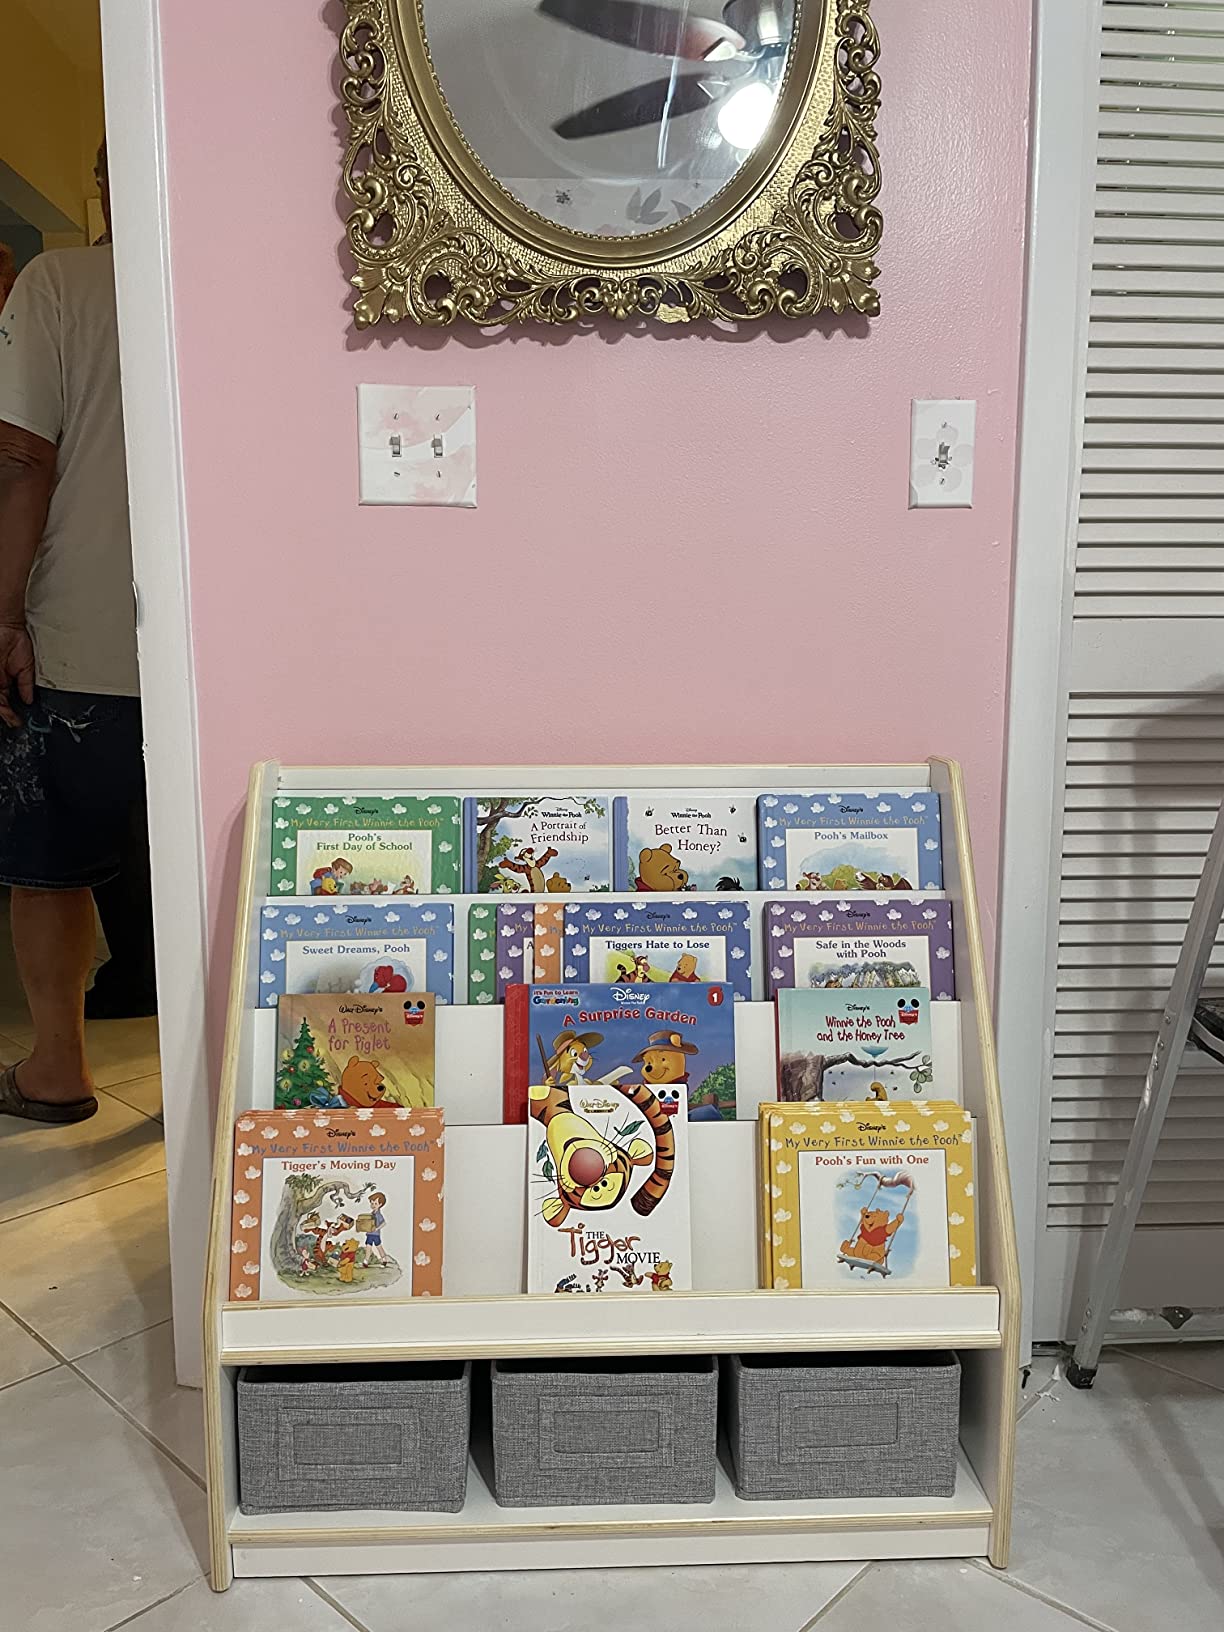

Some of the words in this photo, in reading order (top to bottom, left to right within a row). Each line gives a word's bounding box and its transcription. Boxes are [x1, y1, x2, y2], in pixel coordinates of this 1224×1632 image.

[291, 818, 303, 829] My
[306, 818, 330, 828] Very
[333, 818, 359, 827] First
[363, 818, 393, 827] Winnie
[398, 818, 415, 827] the
[531, 823, 538, 831] A
[541, 822, 577, 830] Portrait
[579, 822, 587, 830] of
[779, 817, 791, 827] My
[794, 817, 816, 826] Very
[820, 816, 845, 825] First
[848, 816, 880, 825] Winnie
[883, 816, 900, 824] the
[655, 824, 692, 836] Better
[697, 824, 727, 836] Than
[814, 831, 847, 840] Pooh's
[850, 831, 889, 840] Mailbox
[348, 833, 382, 842] Pooh's
[531, 831, 589, 844] Friendship
[316, 842, 340, 851] First
[343, 842, 362, 852] Day
[366, 842, 377, 851] of
[379, 842, 413, 851] School
[678, 839, 721, 854] Honey?
[582, 924, 596, 935] My
[598, 923, 622, 933] Very
[625, 923, 651, 933] First
[654, 922, 687, 932] Winnie
[692, 922, 708, 932] the
[784, 923, 796, 933] My
[799, 923, 823, 933] Very
[826, 922, 854, 931] First
[855, 921, 887, 930] Winnie
[891, 921, 908, 930] the
[302, 945, 333, 955] Sweet
[337, 945, 380, 955] Dreams,
[384, 944, 410, 953] Pooh
[605, 940, 642, 951] Tiggers
[646, 940, 670, 949] Hate
[673, 941, 683, 949] to
[686, 940, 710, 949] Lose
[815, 940, 838, 949] Safe
[841, 940, 851, 949] in
[854, 940, 870, 949] the
[872, 940, 906, 948] Woods
[836, 950, 858, 959] with
[861, 949, 887, 958] Pooh
[610, 987, 650, 1003] Disney
[712, 992, 718, 1003] 1
[563, 1015, 576, 1028] A
[579, 1007, 641, 1022] Surprise
[645, 1007, 697, 1026] Garden
[825, 1016, 854, 1028] Winnie
[856, 1016, 872, 1028] the
[875, 1015, 896, 1028] Pooh
[328, 1018, 337, 1033] A
[342, 1019, 392, 1034] Present
[817, 1029, 833, 1042] and
[837, 1029, 853, 1042] the
[855, 1030, 882, 1043] Honey
[884, 1029, 906, 1041] Tree
[328, 1035, 350, 1051] for
[355, 1035, 391, 1055] Piglet
[785, 1137, 801, 1149] My
[804, 1137, 831, 1148] Very
[835, 1137, 865, 1147] First
[868, 1135, 906, 1146] Winnie
[910, 1135, 929, 1145] the
[251, 1145, 266, 1155] My
[269, 1144, 298, 1154] Very
[302, 1143, 333, 1153] First
[338, 1142, 375, 1152] Winnie
[380, 1142, 400, 1152] the
[281, 1161, 326, 1172] Tigger's
[330, 1160, 370, 1171] Moving
[374, 1160, 396, 1171] Day
[815, 1156, 852, 1166] Pooh's
[856, 1156, 876, 1165] Fun
[880, 1155, 903, 1165] with
[906, 1155, 929, 1164] One
[586, 1231, 605, 1239] THE
[558, 1222, 641, 1265] Tigger
[616, 1252, 661, 1264] MOVIE
